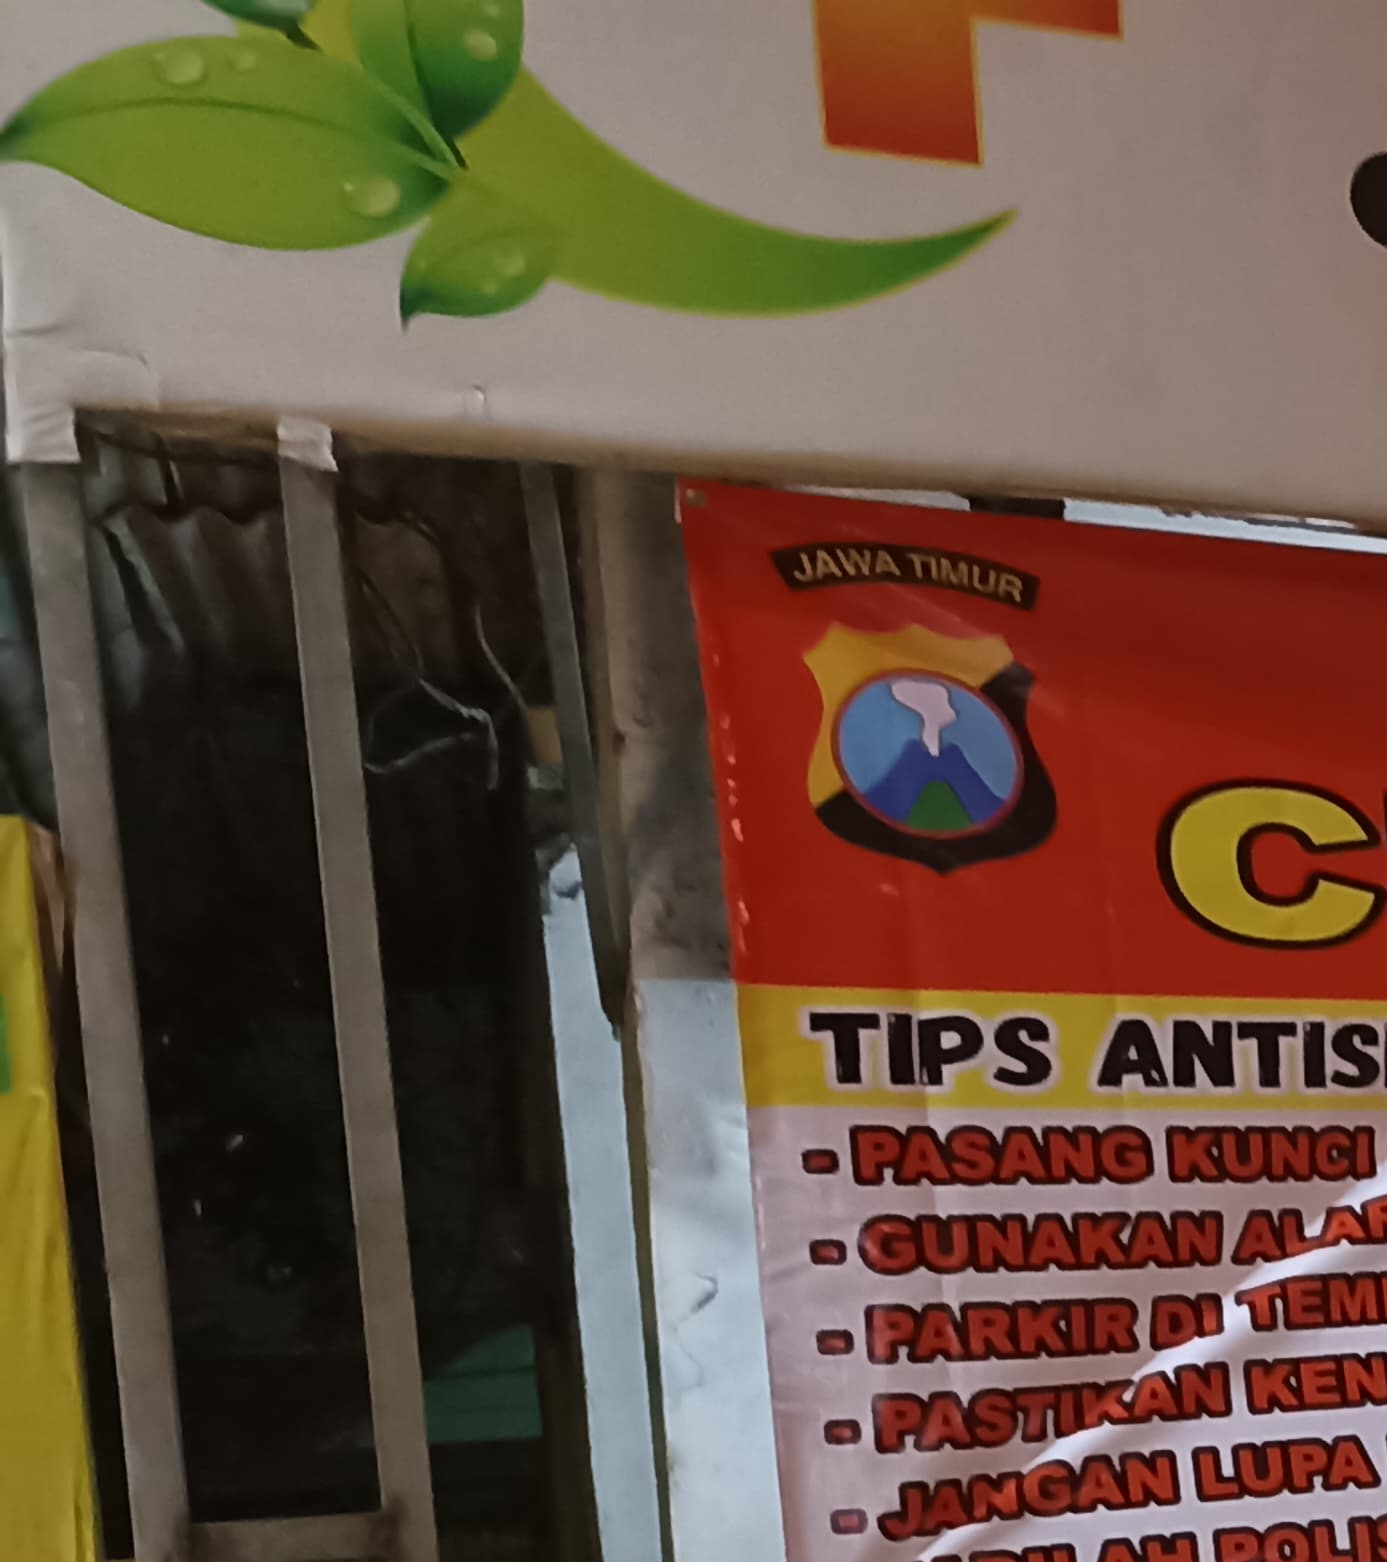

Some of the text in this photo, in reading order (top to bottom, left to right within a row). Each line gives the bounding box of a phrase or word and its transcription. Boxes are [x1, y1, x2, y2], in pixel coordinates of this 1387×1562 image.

[792, 547, 1023, 603] JAWA TIMUR
[809, 1011, 1053, 1086] TIPS
[849, 1124, 1154, 1186] PASANG
[1166, 1124, 1377, 1184] KUNCI
[857, 1210, 1224, 1276] GUNAKAN
[864, 1297, 1139, 1365] PARKIR
[1150, 1291, 1225, 1351] DI
[871, 1361, 1232, 1454] PASTIKAN
[876, 1449, 1182, 1542] JANGAN
[1191, 1435, 1381, 1503] LUPA
